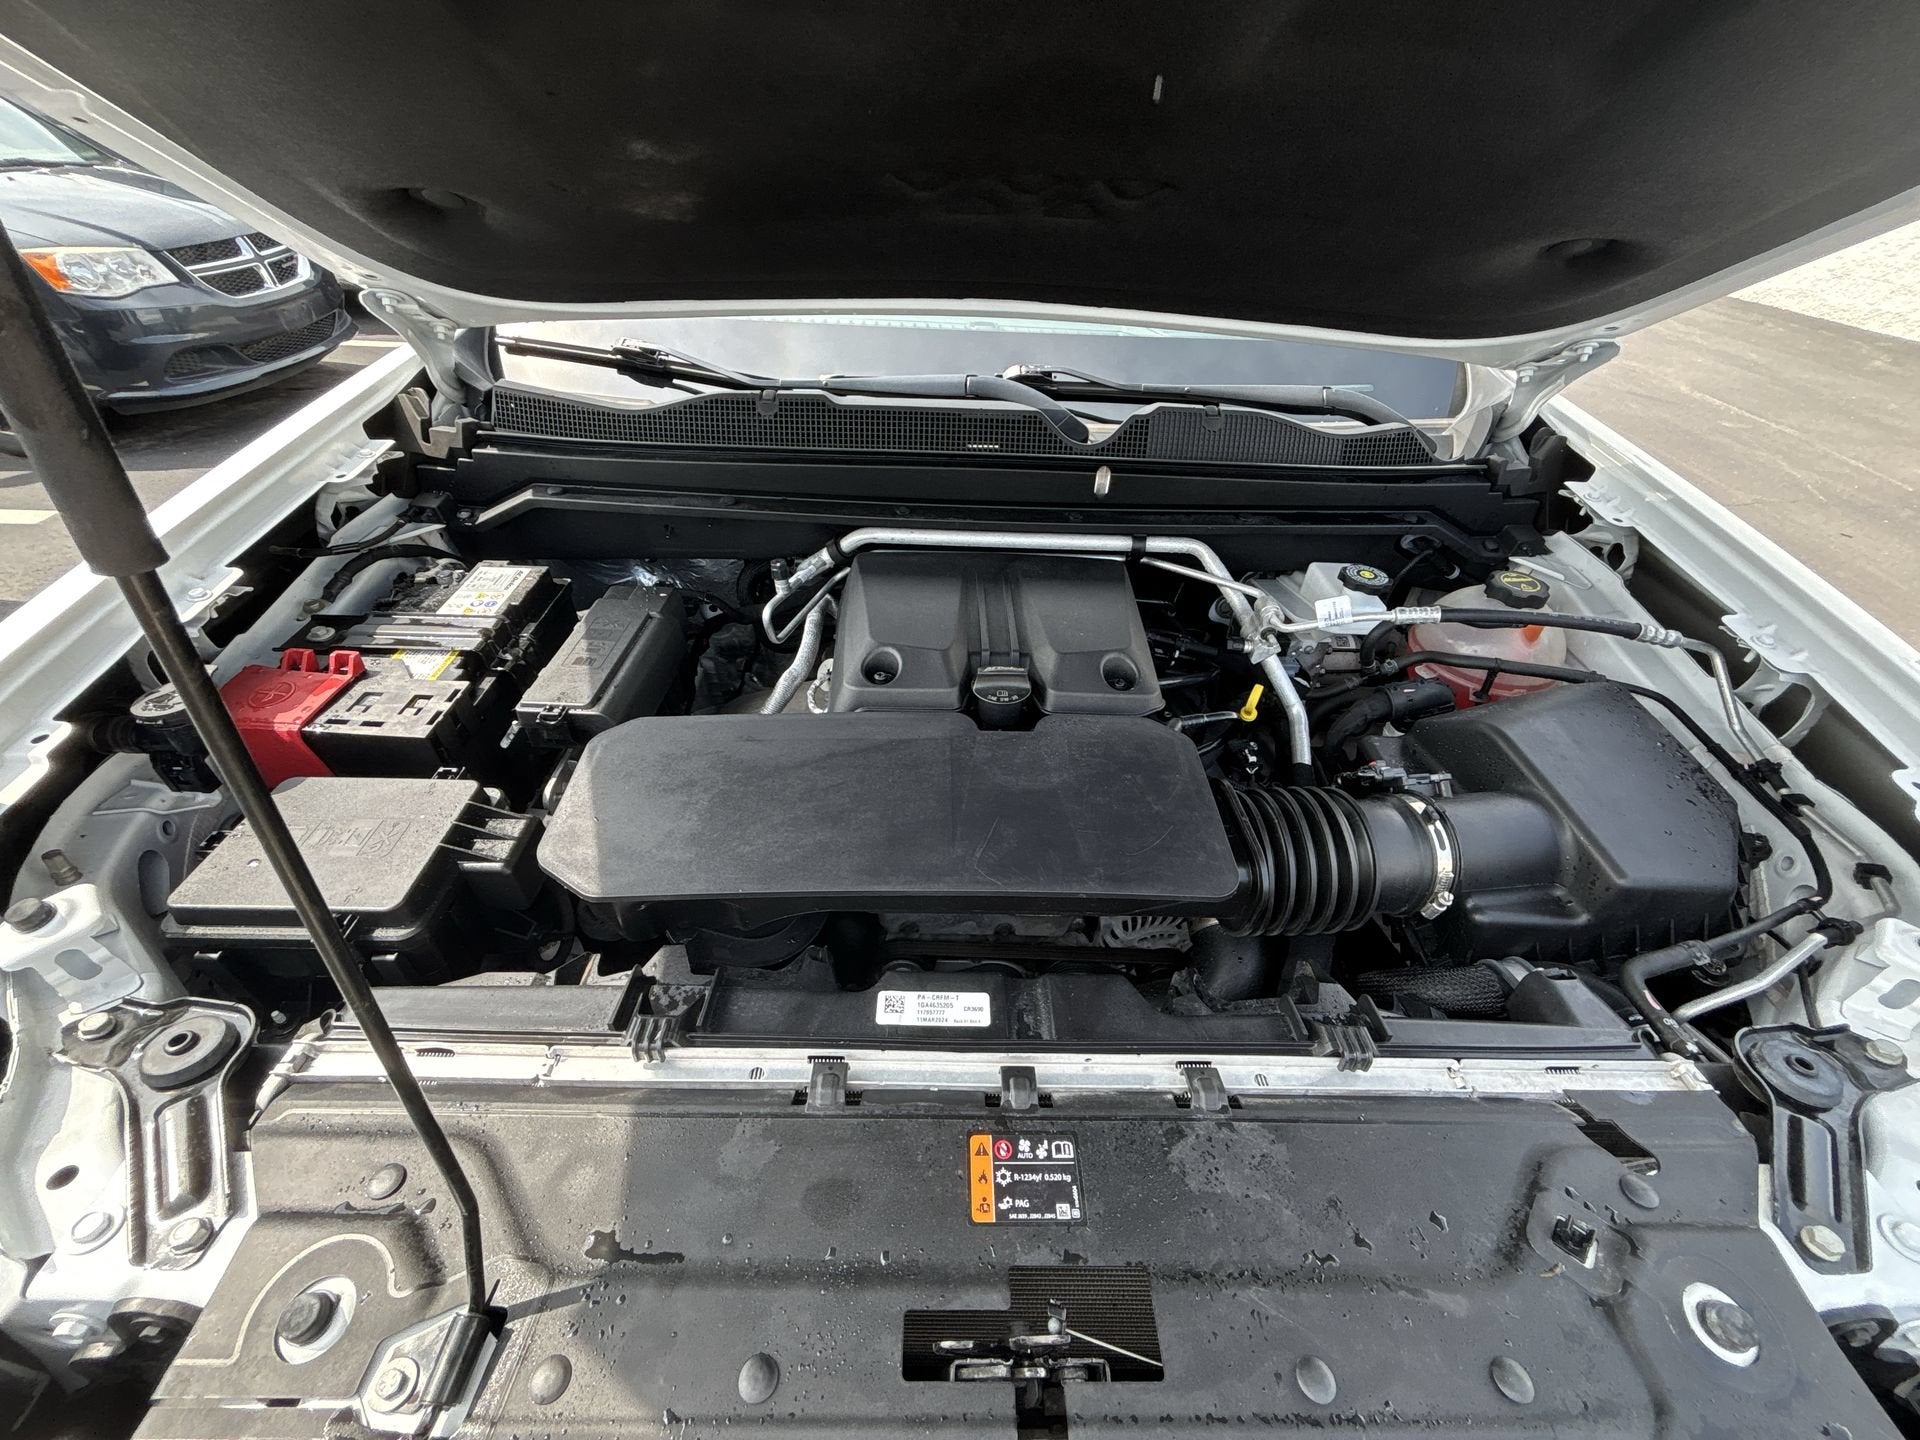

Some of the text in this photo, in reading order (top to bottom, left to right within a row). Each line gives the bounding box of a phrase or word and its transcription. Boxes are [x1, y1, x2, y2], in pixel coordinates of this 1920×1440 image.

[1014, 1173, 1072, 1183] R-1234yf 0.520 kg
[1015, 1199, 1030, 1208] PAG
